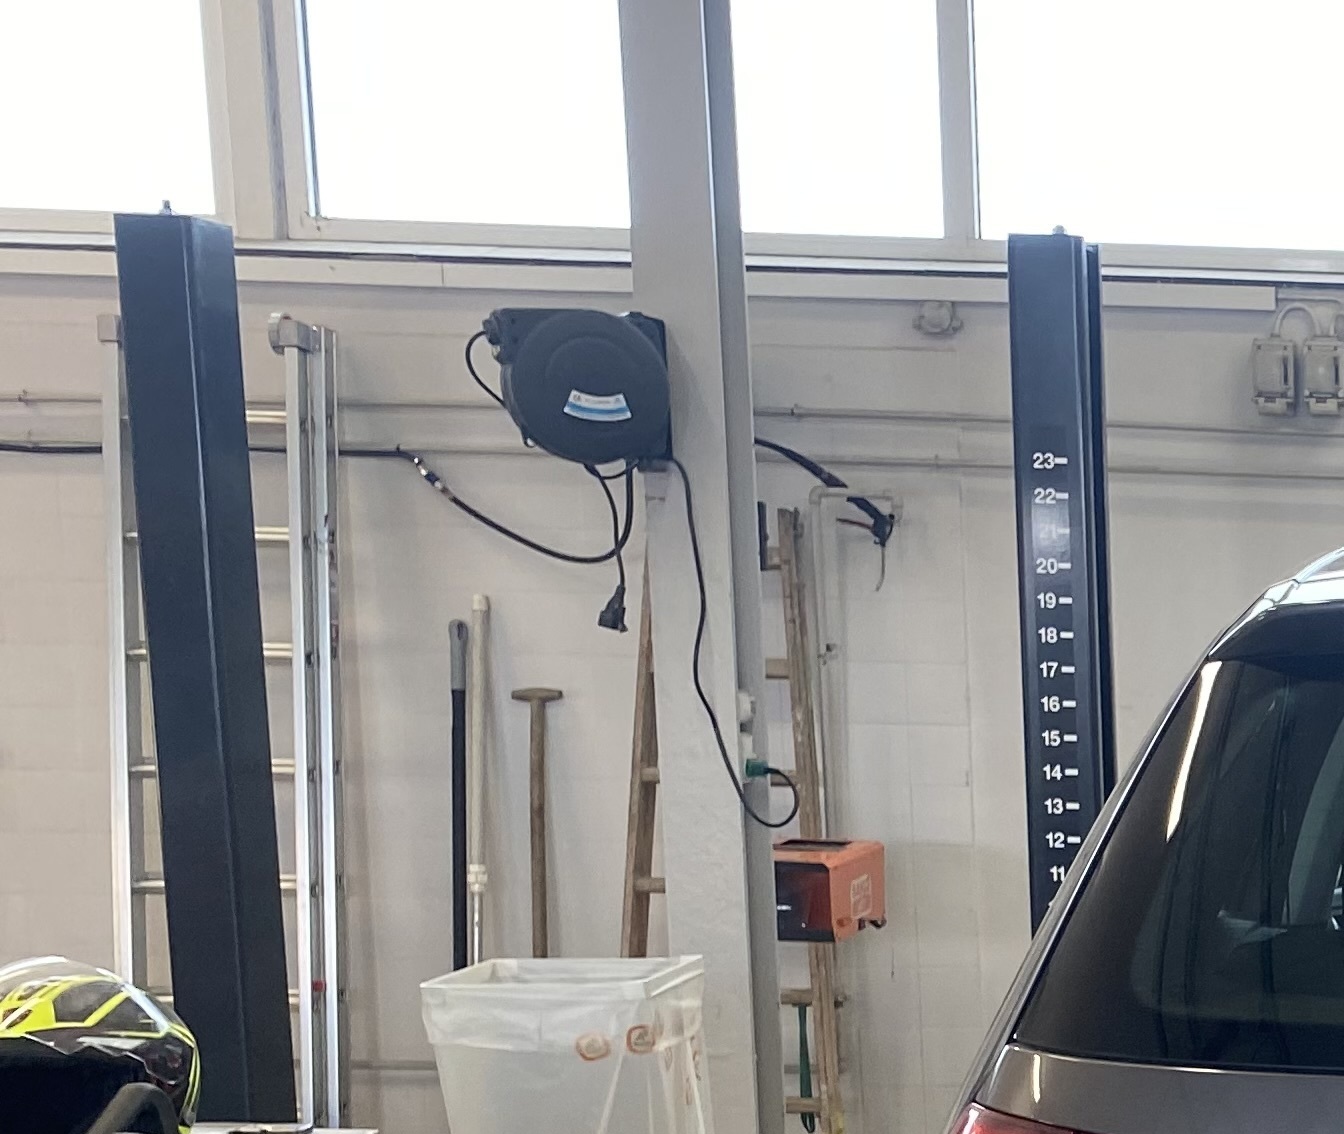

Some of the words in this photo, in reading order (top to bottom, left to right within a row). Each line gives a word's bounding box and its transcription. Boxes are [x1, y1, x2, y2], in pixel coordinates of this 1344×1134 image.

[1032, 452, 1055, 469] 23
[1034, 488, 1057, 504] 22
[1036, 558, 1058, 574] 20
[1037, 592, 1057, 609] 19
[1038, 626, 1058, 644] 18
[1039, 661, 1059, 678] 17
[1040, 695, 1061, 713] 16
[1042, 730, 1061, 747] 15
[1043, 764, 1063, 781] 14
[1044, 798, 1064, 815] 13
[1045, 832, 1066, 849] 12
